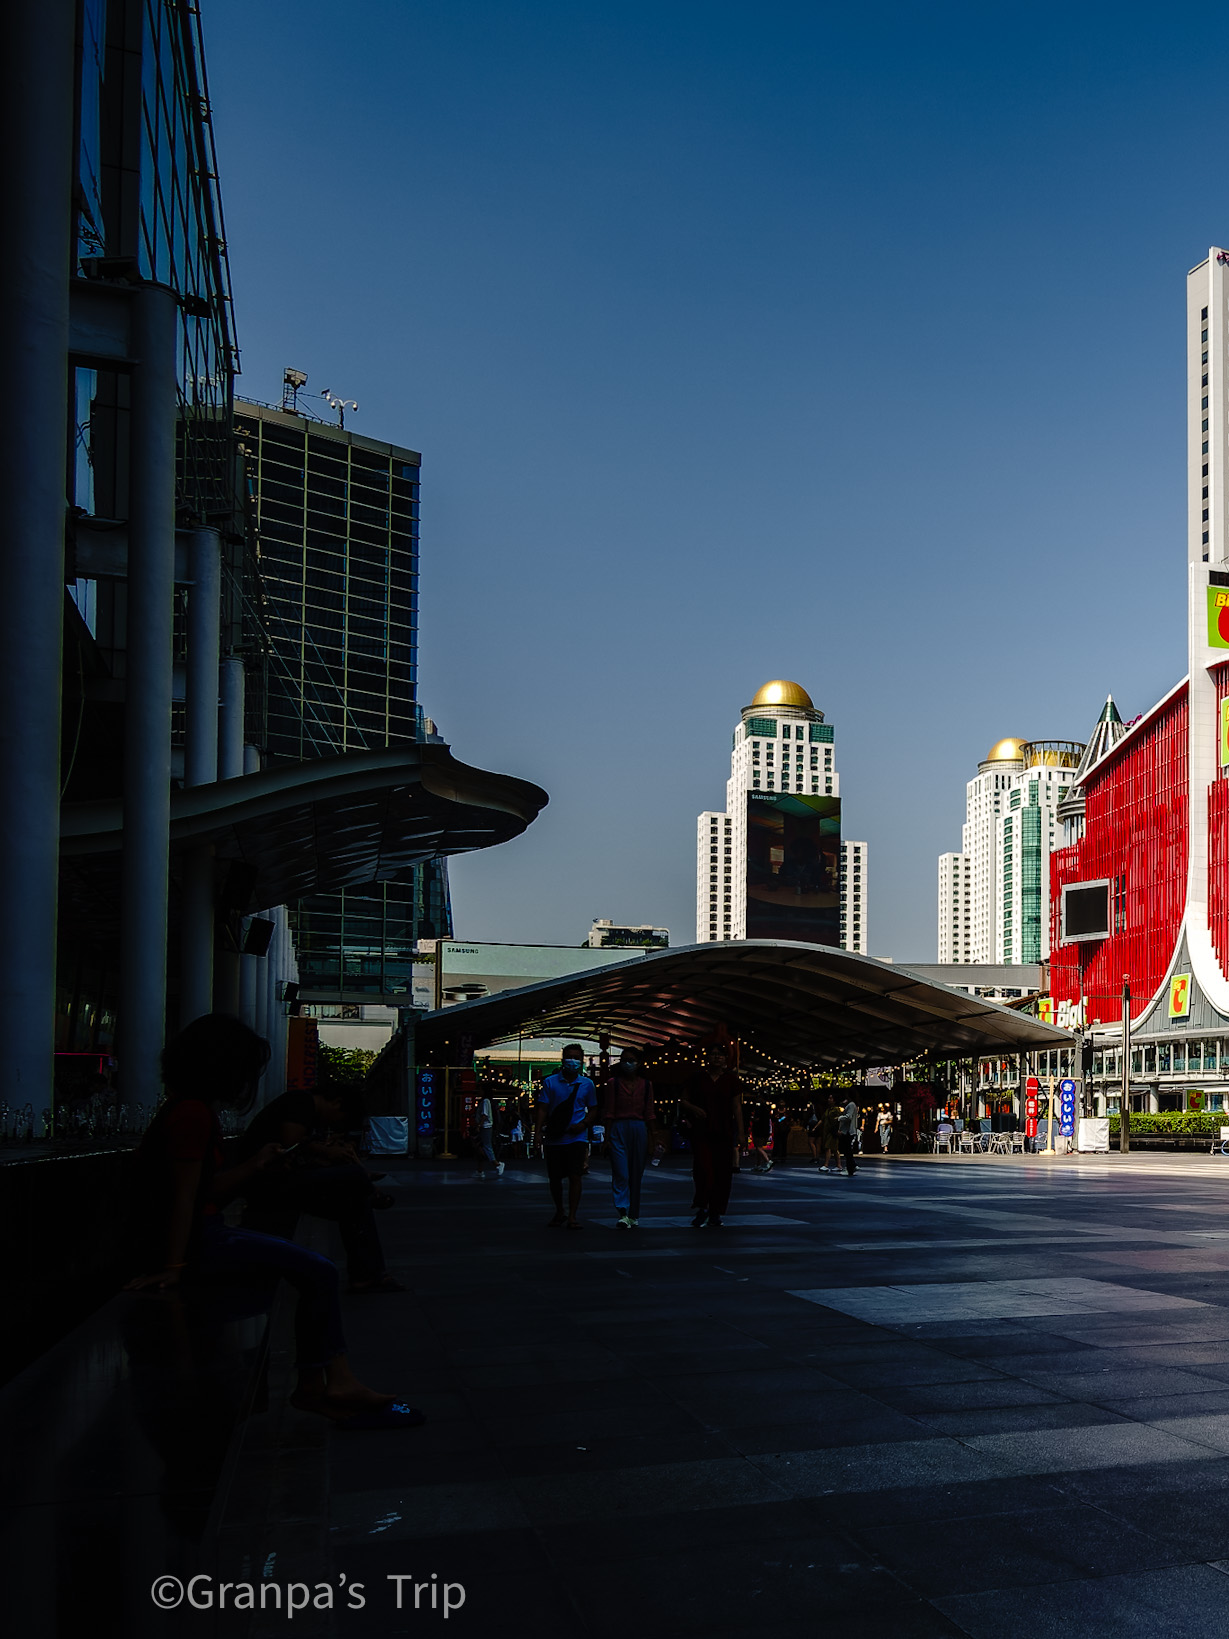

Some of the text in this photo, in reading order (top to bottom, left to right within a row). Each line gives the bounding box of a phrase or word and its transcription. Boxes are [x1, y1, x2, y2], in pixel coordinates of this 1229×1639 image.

[1057, 998, 1079, 1032] Big
[1062, 1083, 1074, 1123] おいしい
